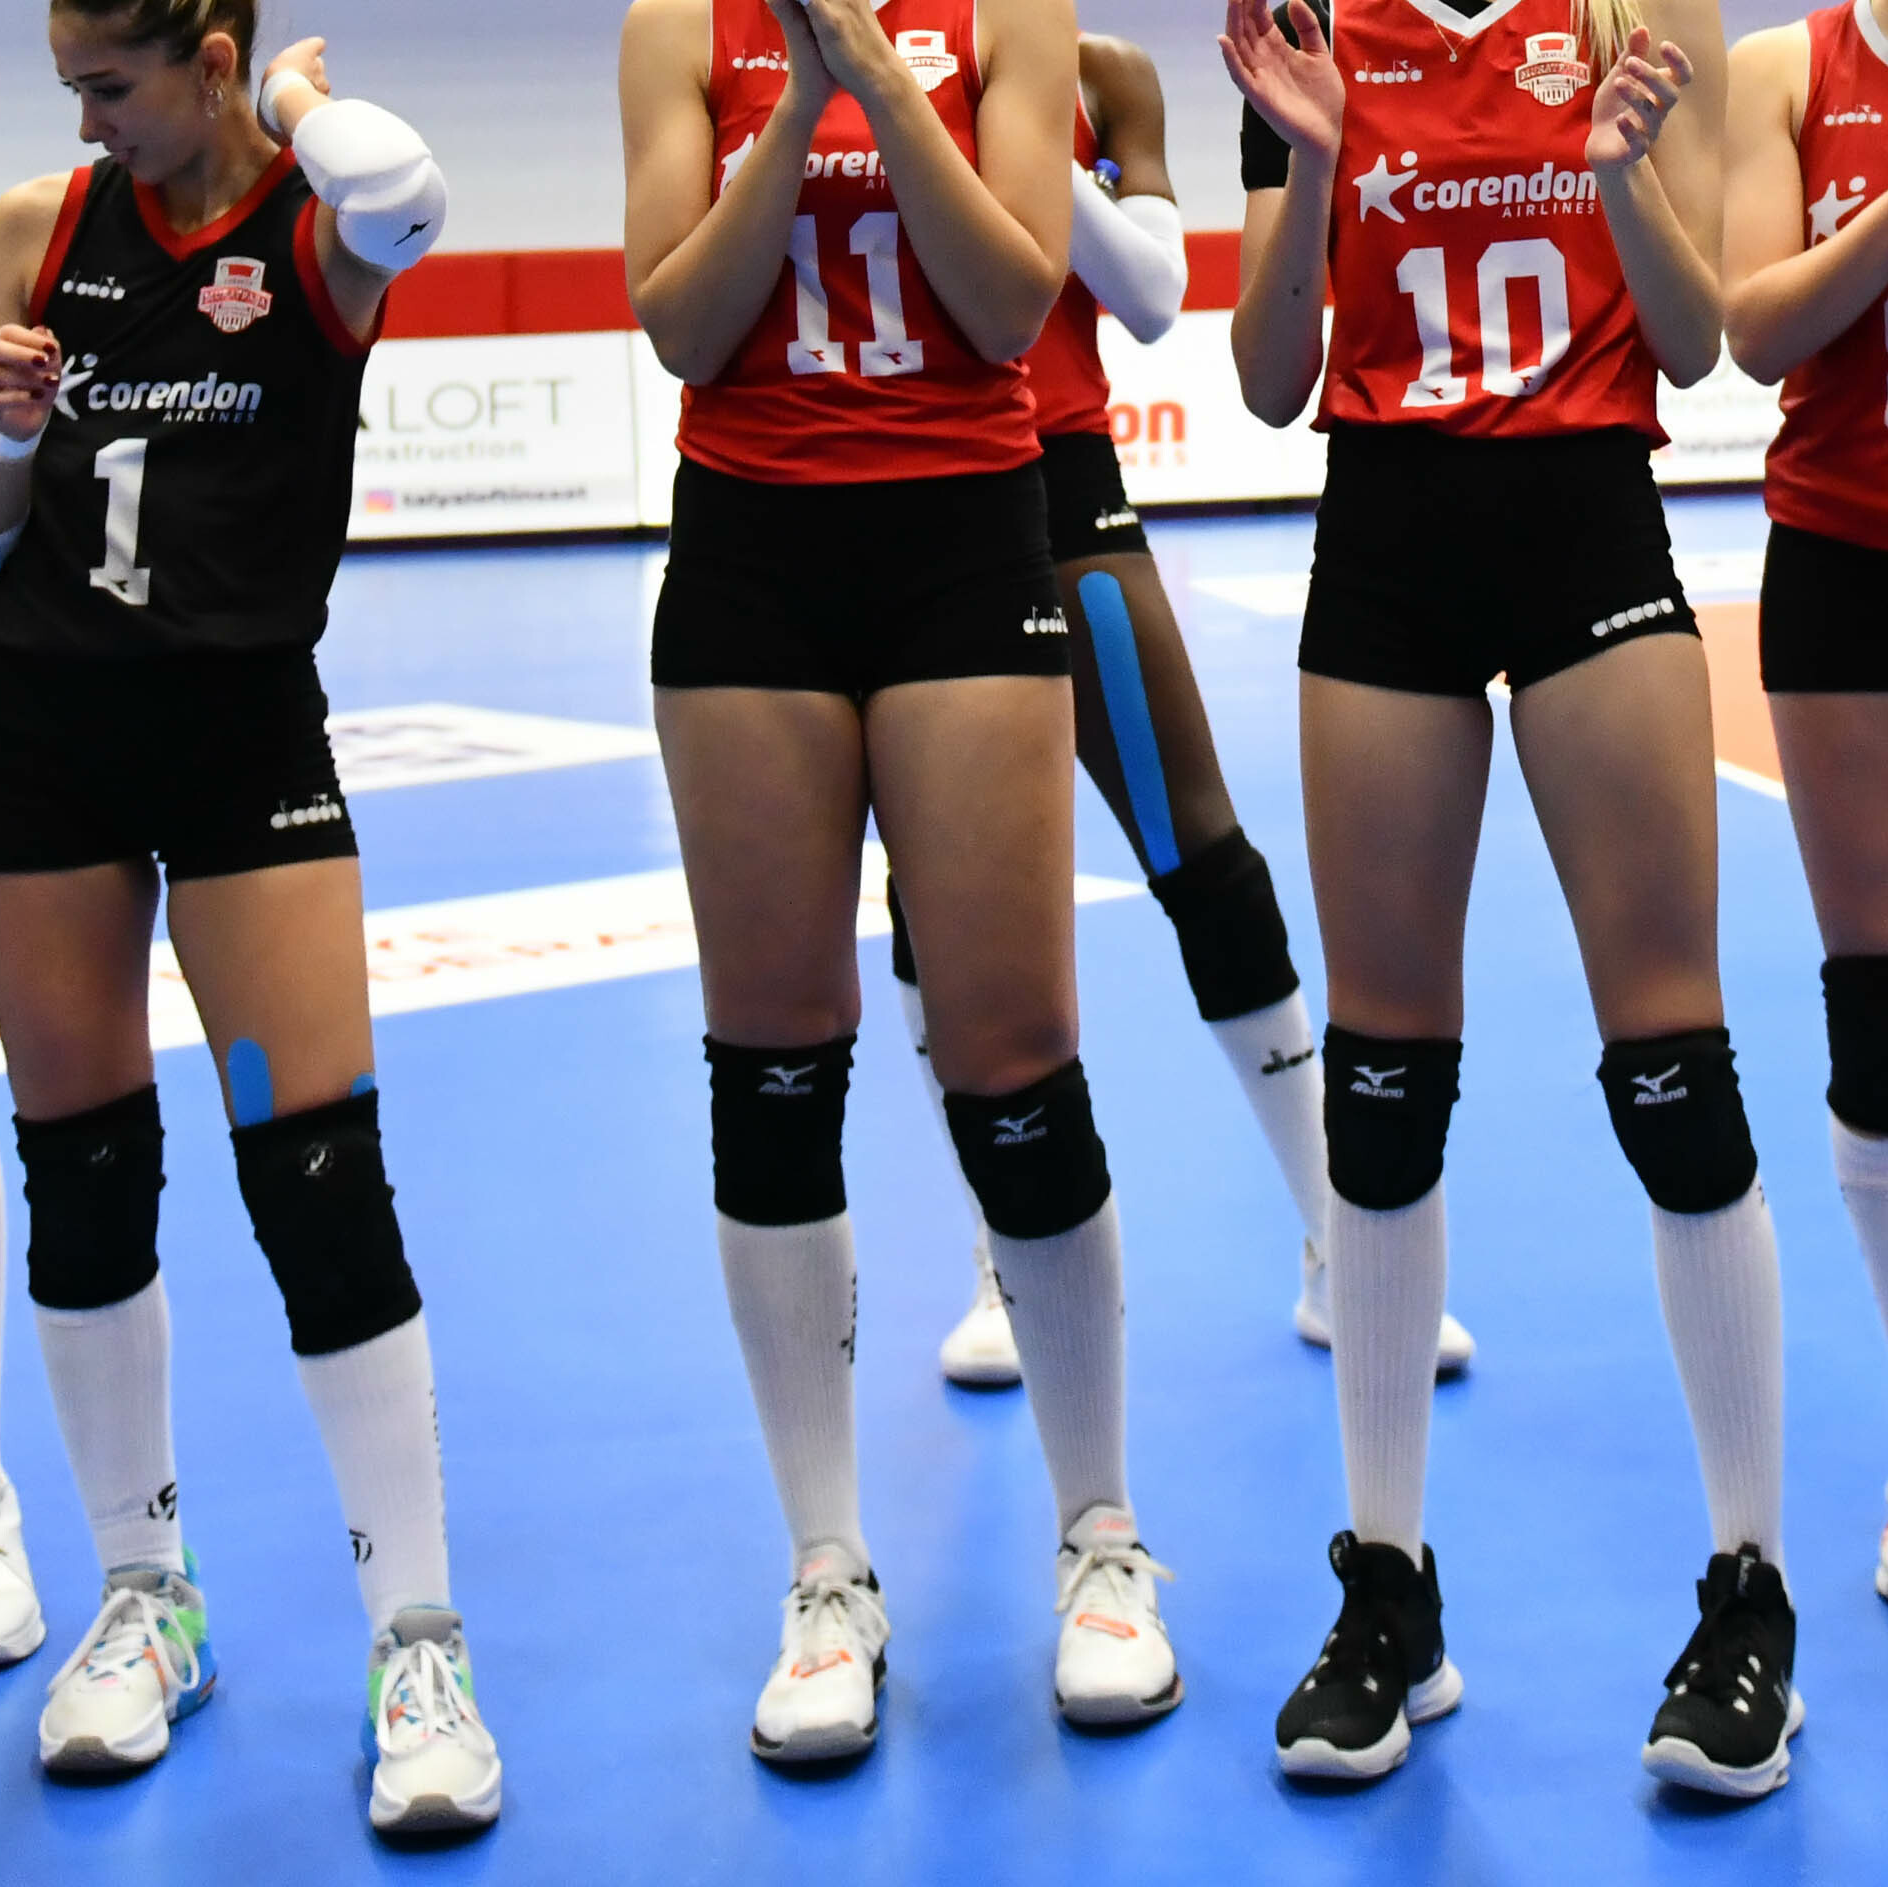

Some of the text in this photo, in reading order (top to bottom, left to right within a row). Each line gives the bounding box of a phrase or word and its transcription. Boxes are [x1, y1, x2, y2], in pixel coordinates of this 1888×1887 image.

[1413, 161, 1597, 212] corendon
[1502, 199, 1596, 219] AIRLINES
[786, 212, 924, 377] 11
[1396, 237, 1571, 409] 10
[88, 371, 262, 412] corendon
[162, 410, 256, 424] AIRLINES
[388, 377, 574, 433] LOFT
[355, 438, 528, 462] nstruction
[89, 437, 150, 606] 1
